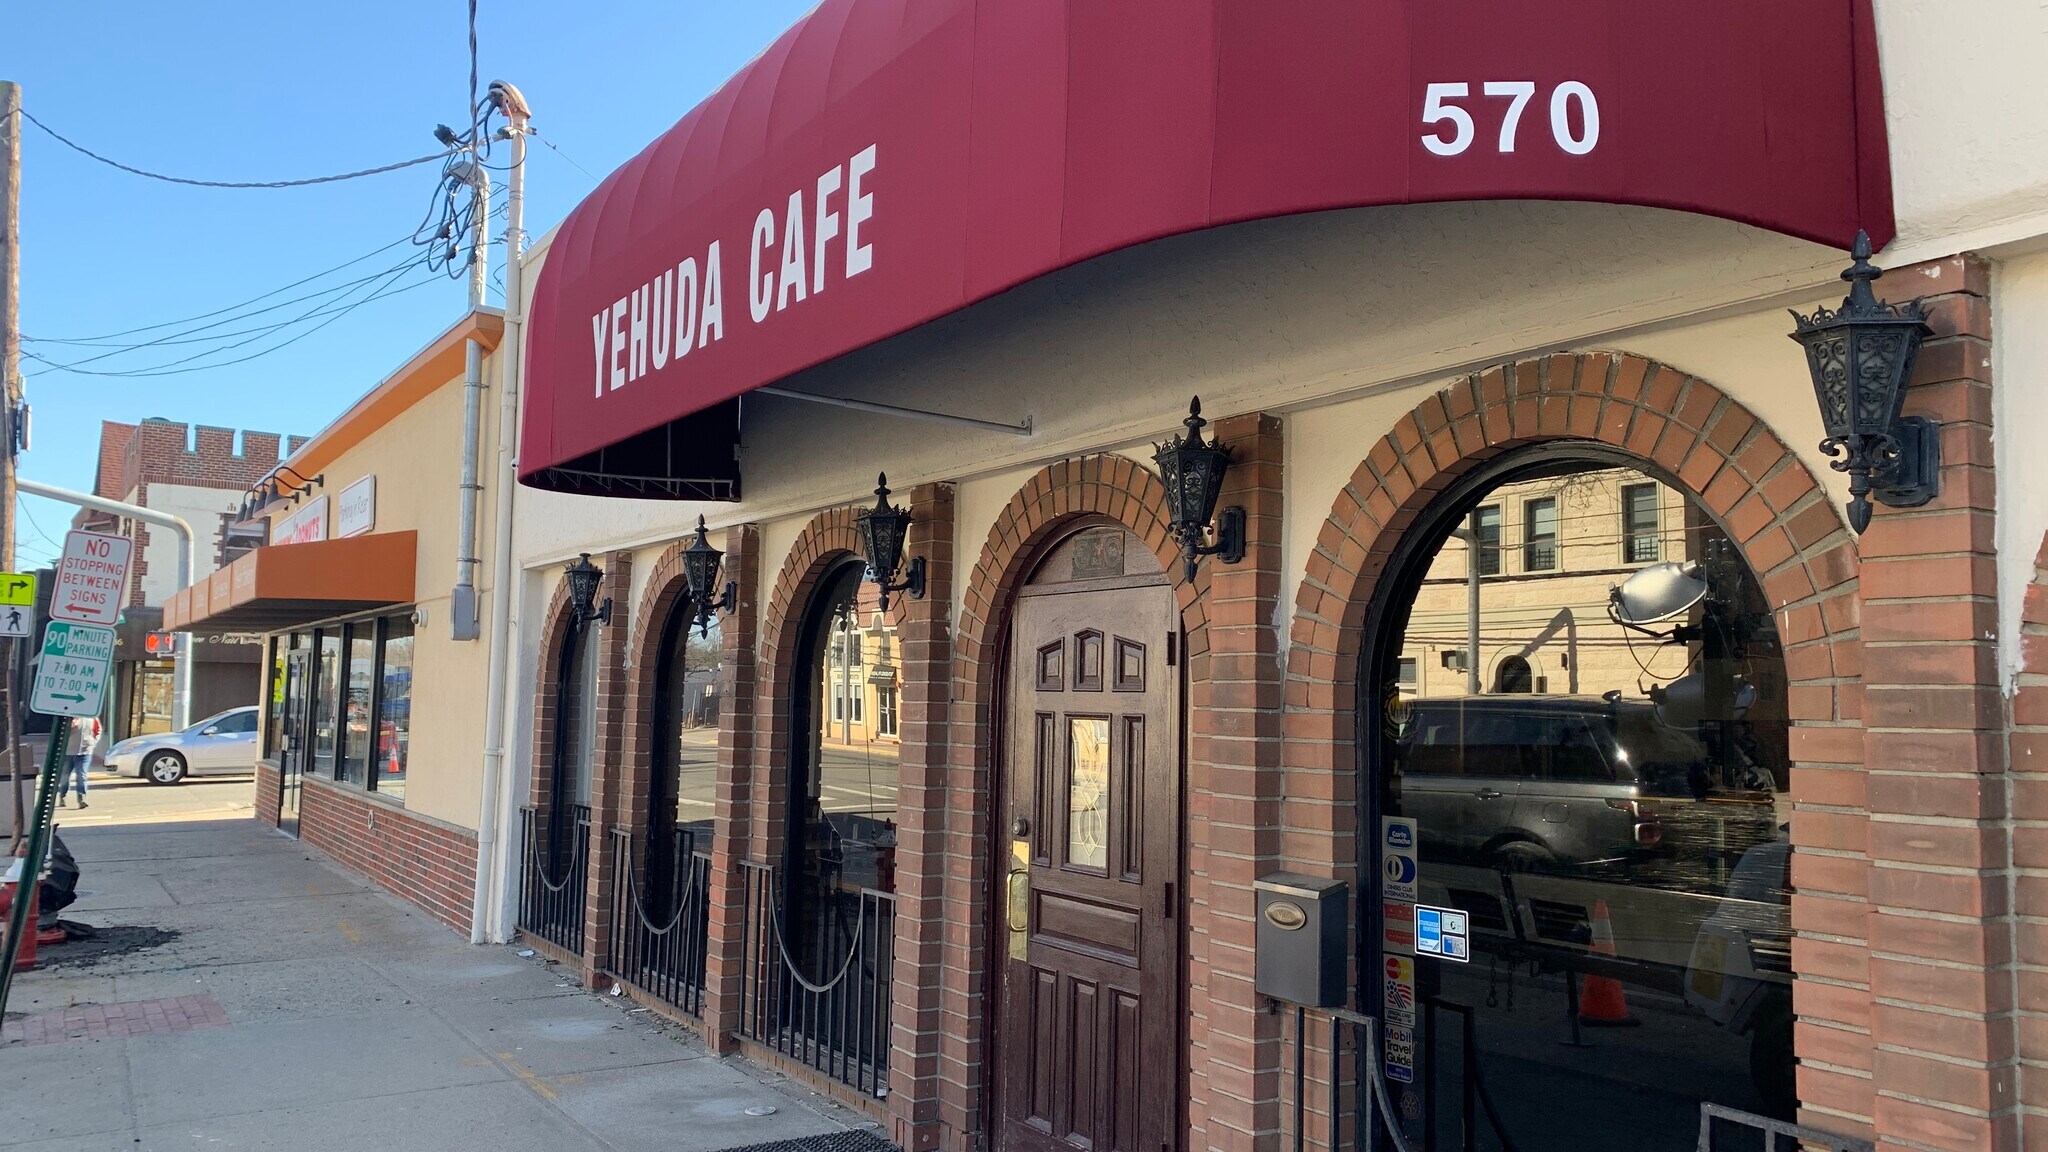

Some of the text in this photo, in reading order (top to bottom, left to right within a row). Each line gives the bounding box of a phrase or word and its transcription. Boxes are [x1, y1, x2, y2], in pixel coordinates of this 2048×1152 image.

[1421, 80, 1600, 156] 570
[592, 142, 877, 399] YEHUDA CAFE
[85, 539, 110, 558] NO
[65, 557, 124, 576] STOPPING
[62, 572, 120, 591] BETWEEN
[70, 589, 107, 605] SIGNS
[46, 629, 107, 649] 90 MINUTE
[65, 642, 109, 660] PARKING
[80, 665, 95, 677] AM
[44, 677, 99, 694] TO 7:00 PM
[1385, 1027, 1412, 1042] Mobil
[1386, 1039, 1412, 1055] Travel
[1386, 1051, 1412, 1067] Guide
